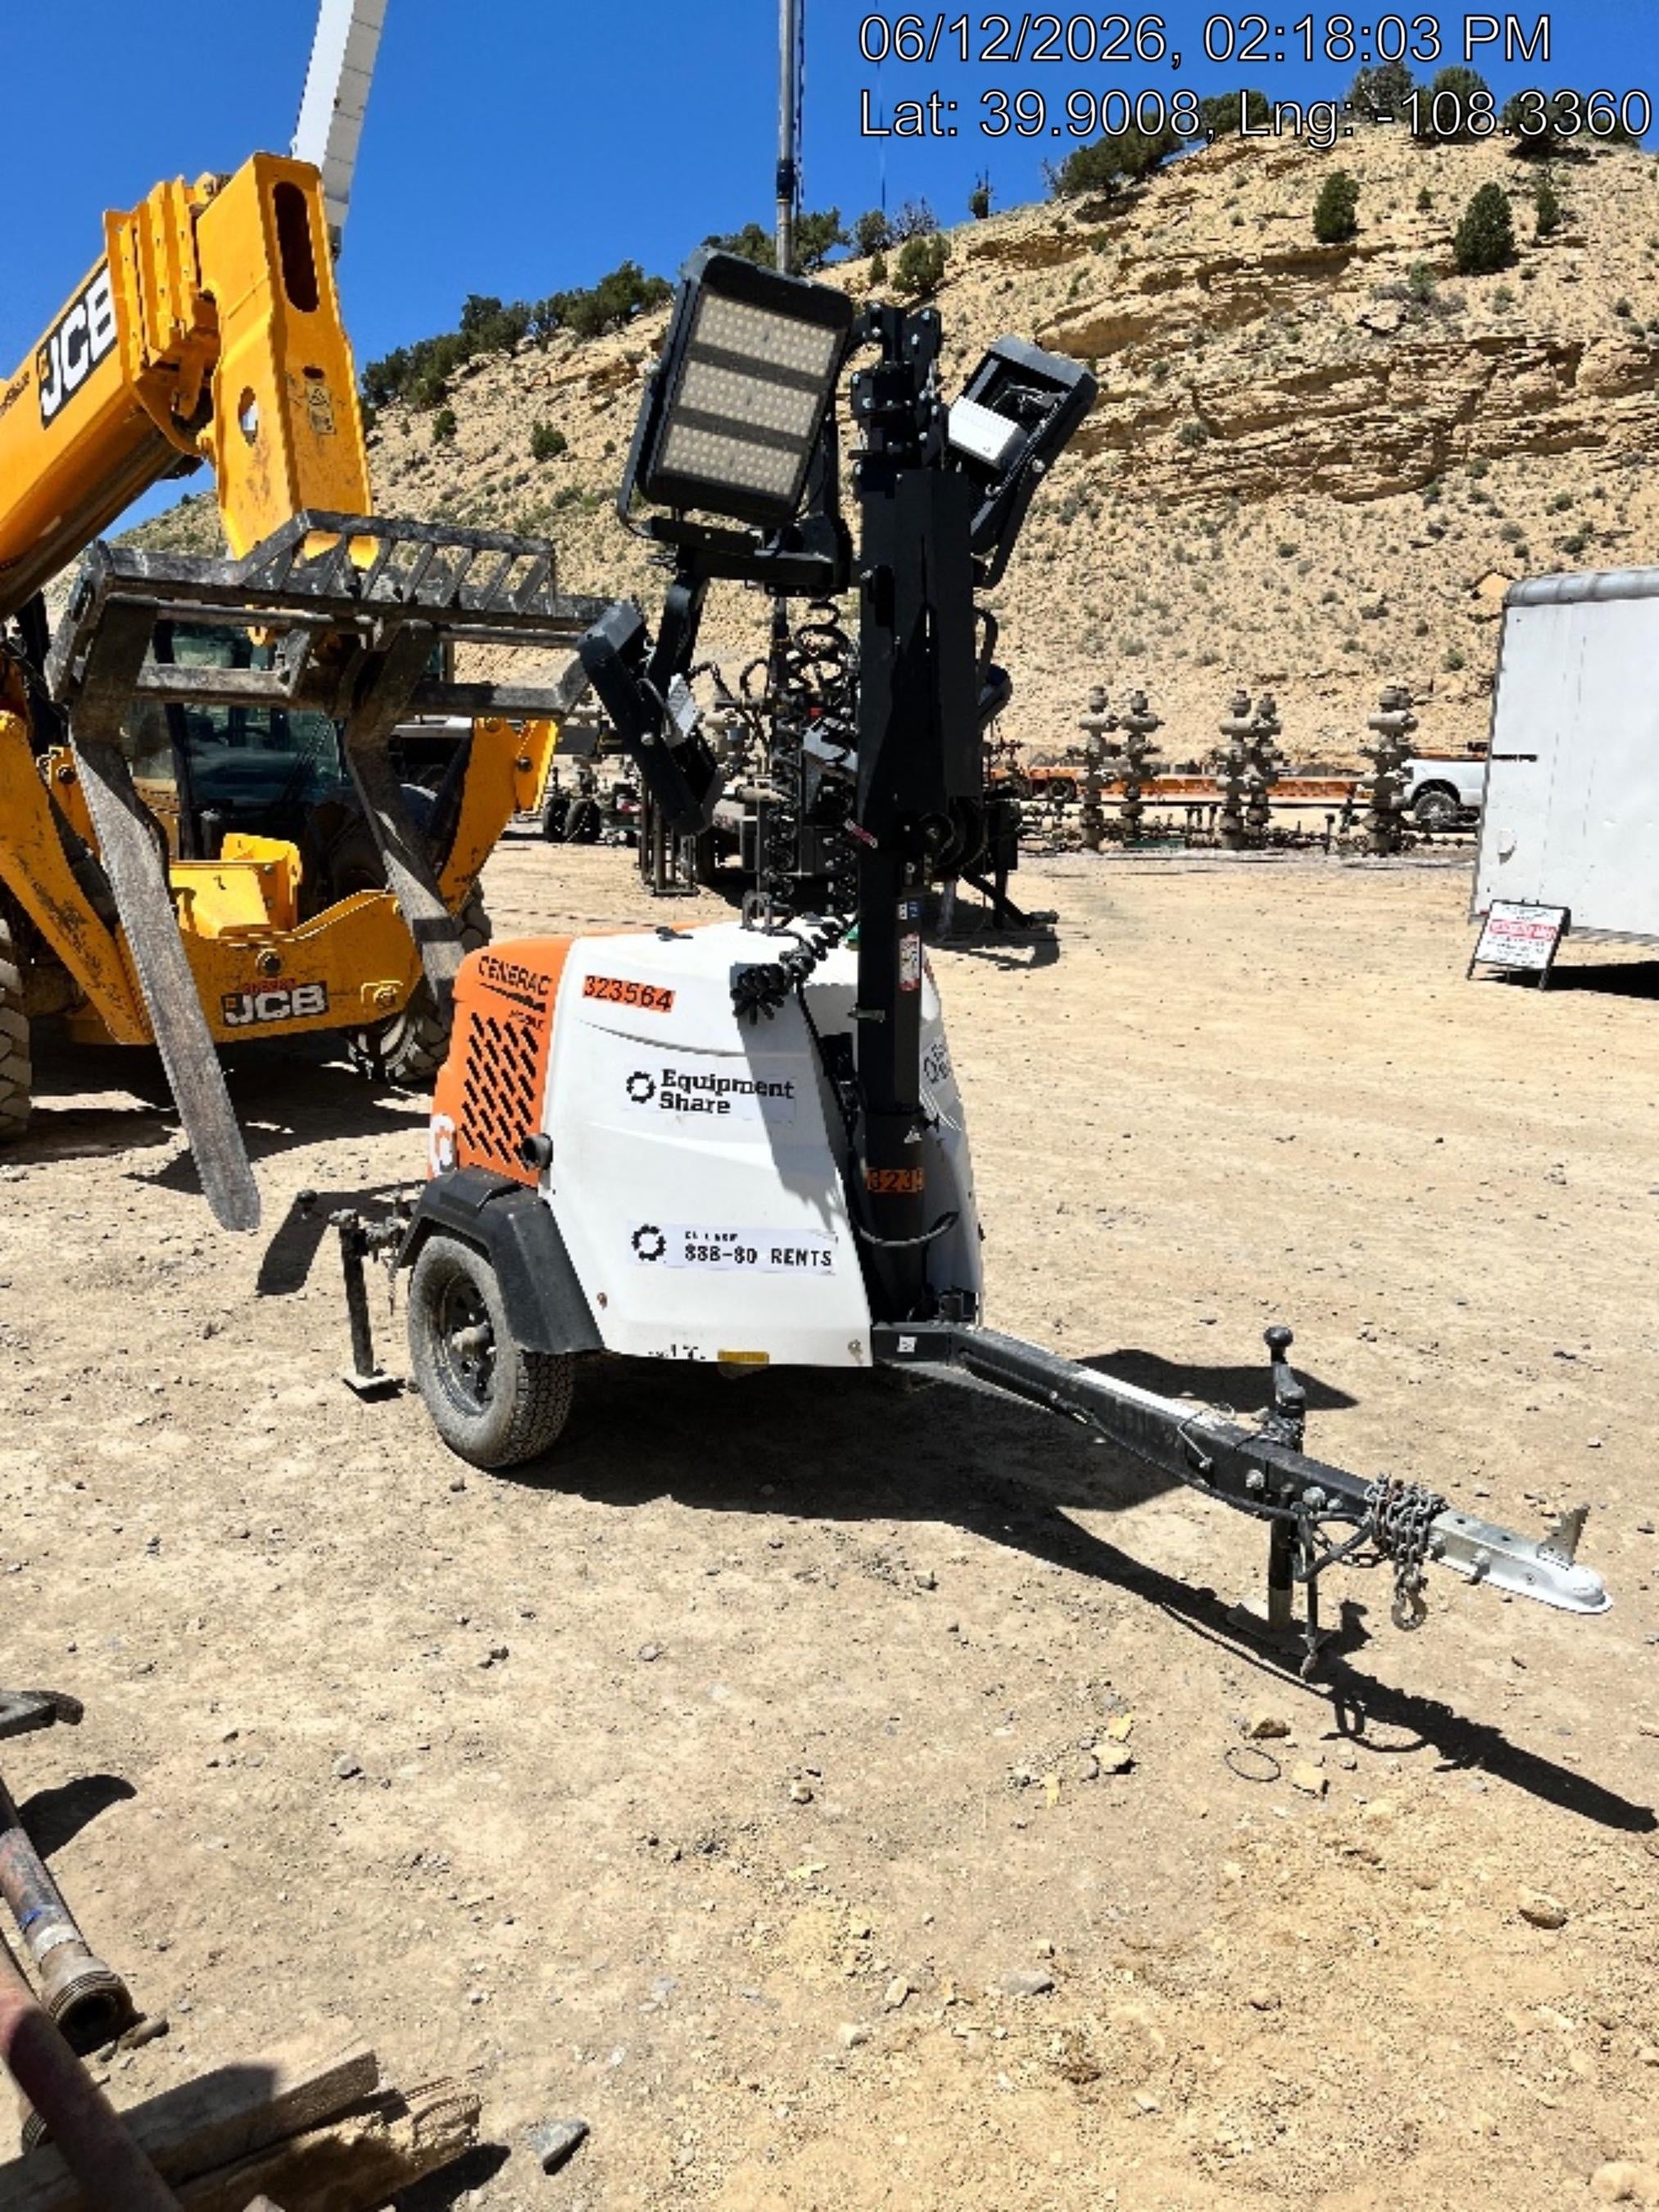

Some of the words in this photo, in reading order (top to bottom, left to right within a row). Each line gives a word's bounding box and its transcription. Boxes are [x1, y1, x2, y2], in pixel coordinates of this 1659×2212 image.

[41, 265, 117, 417] JCB
[224, 984, 326, 1024] JCB
[584, 975, 676, 1011] 323564
[660, 1068, 795, 1099] Equipment
[659, 1091, 732, 1114] Share
[771, 1247, 832, 1267] RENTS
